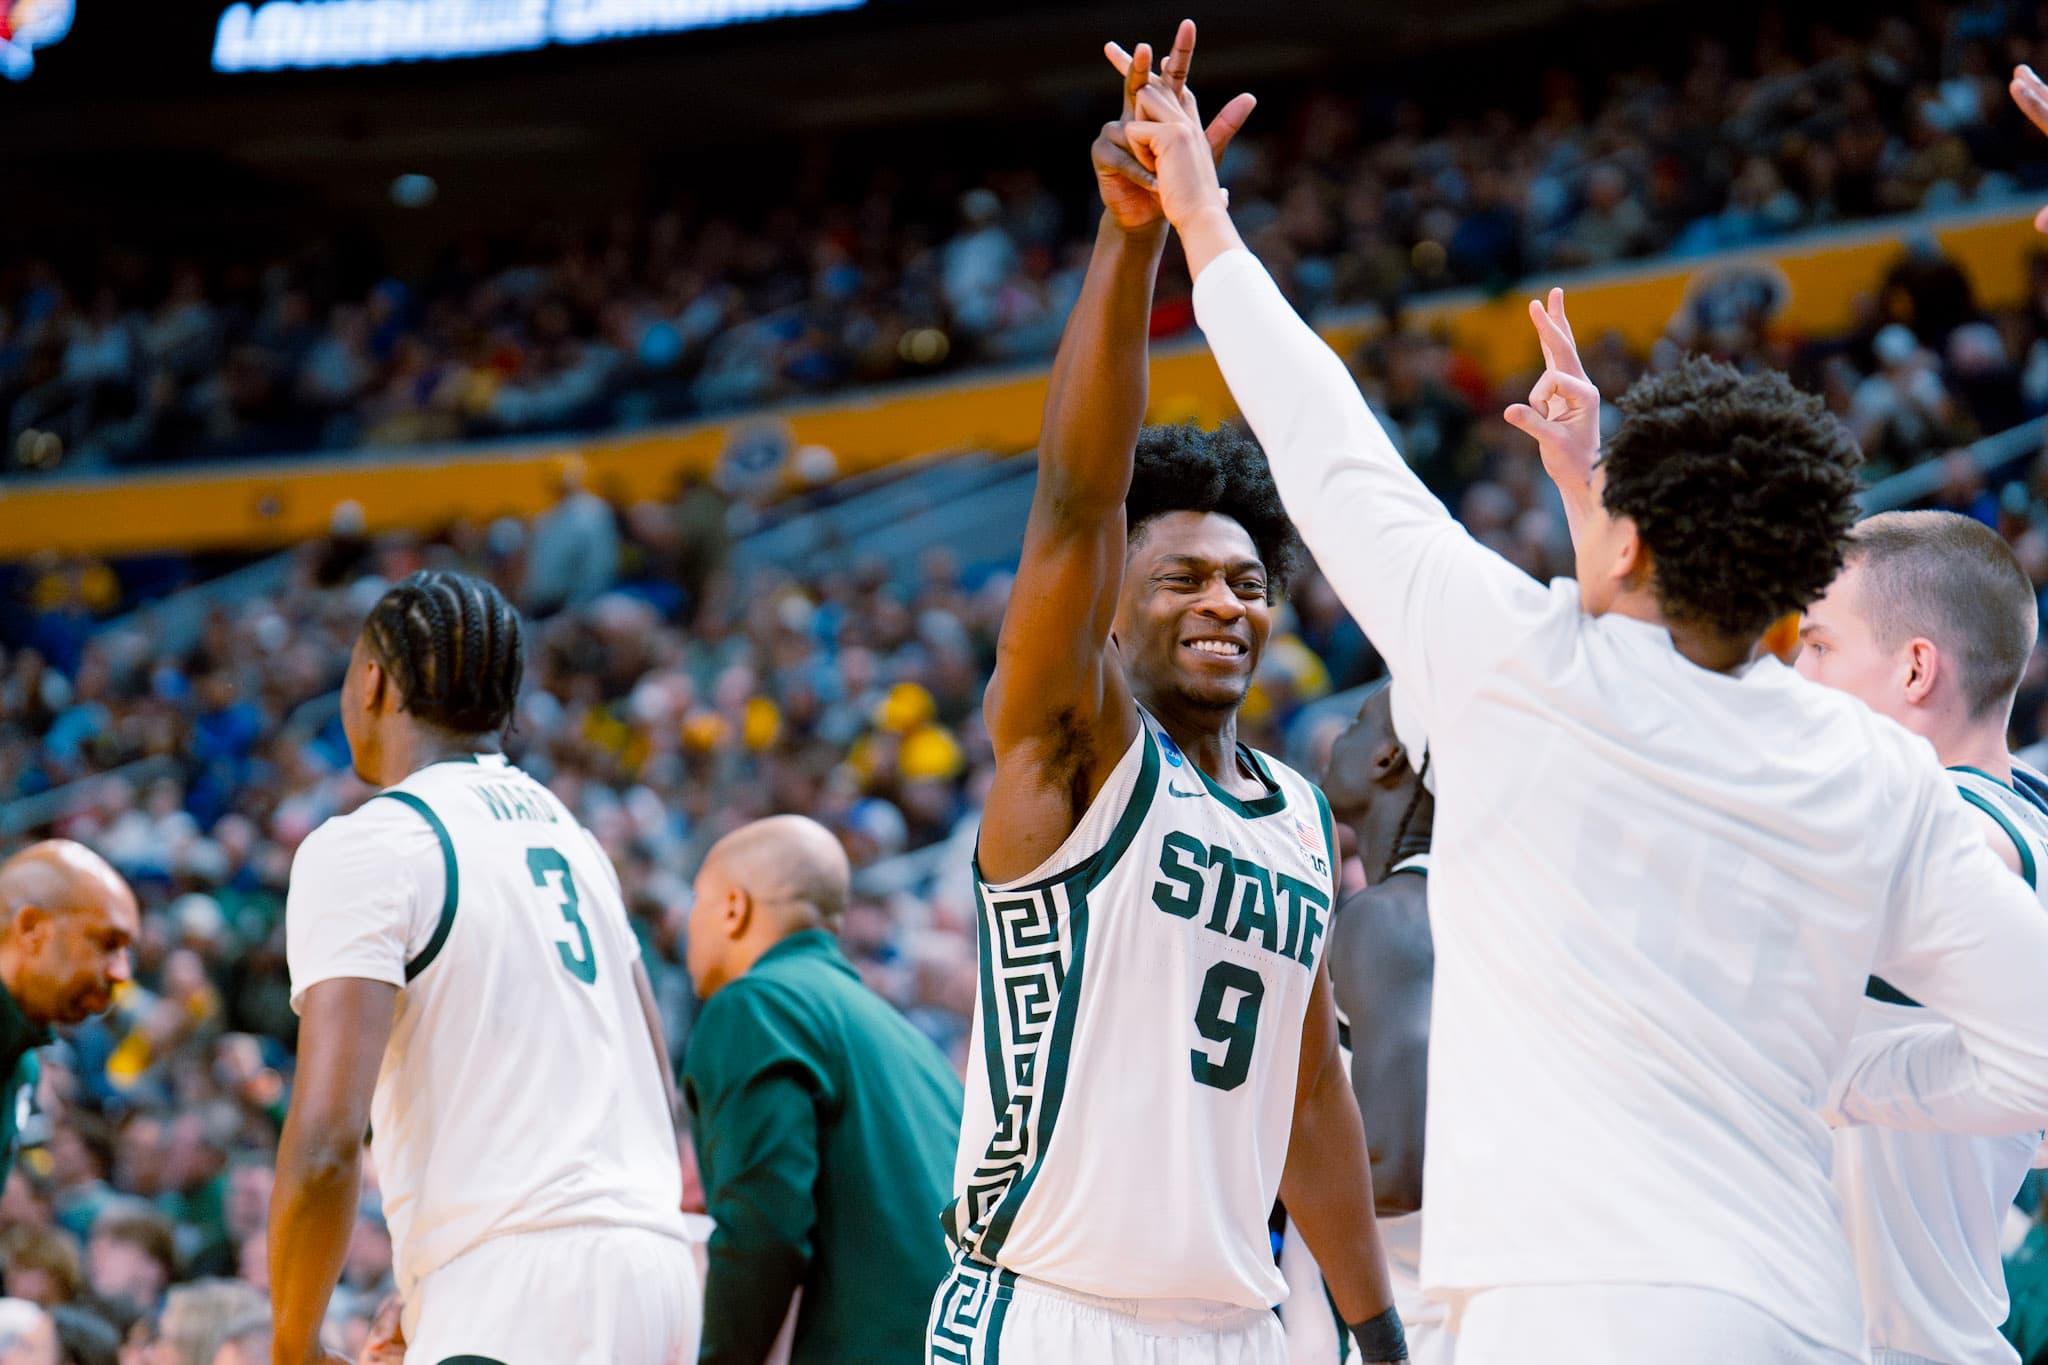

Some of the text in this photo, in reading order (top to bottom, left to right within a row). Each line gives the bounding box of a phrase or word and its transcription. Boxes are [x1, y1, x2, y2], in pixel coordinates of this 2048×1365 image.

[526, 847, 597, 985] 3
[1152, 830, 1330, 972] STATE
[1190, 960, 1265, 1092] 9
